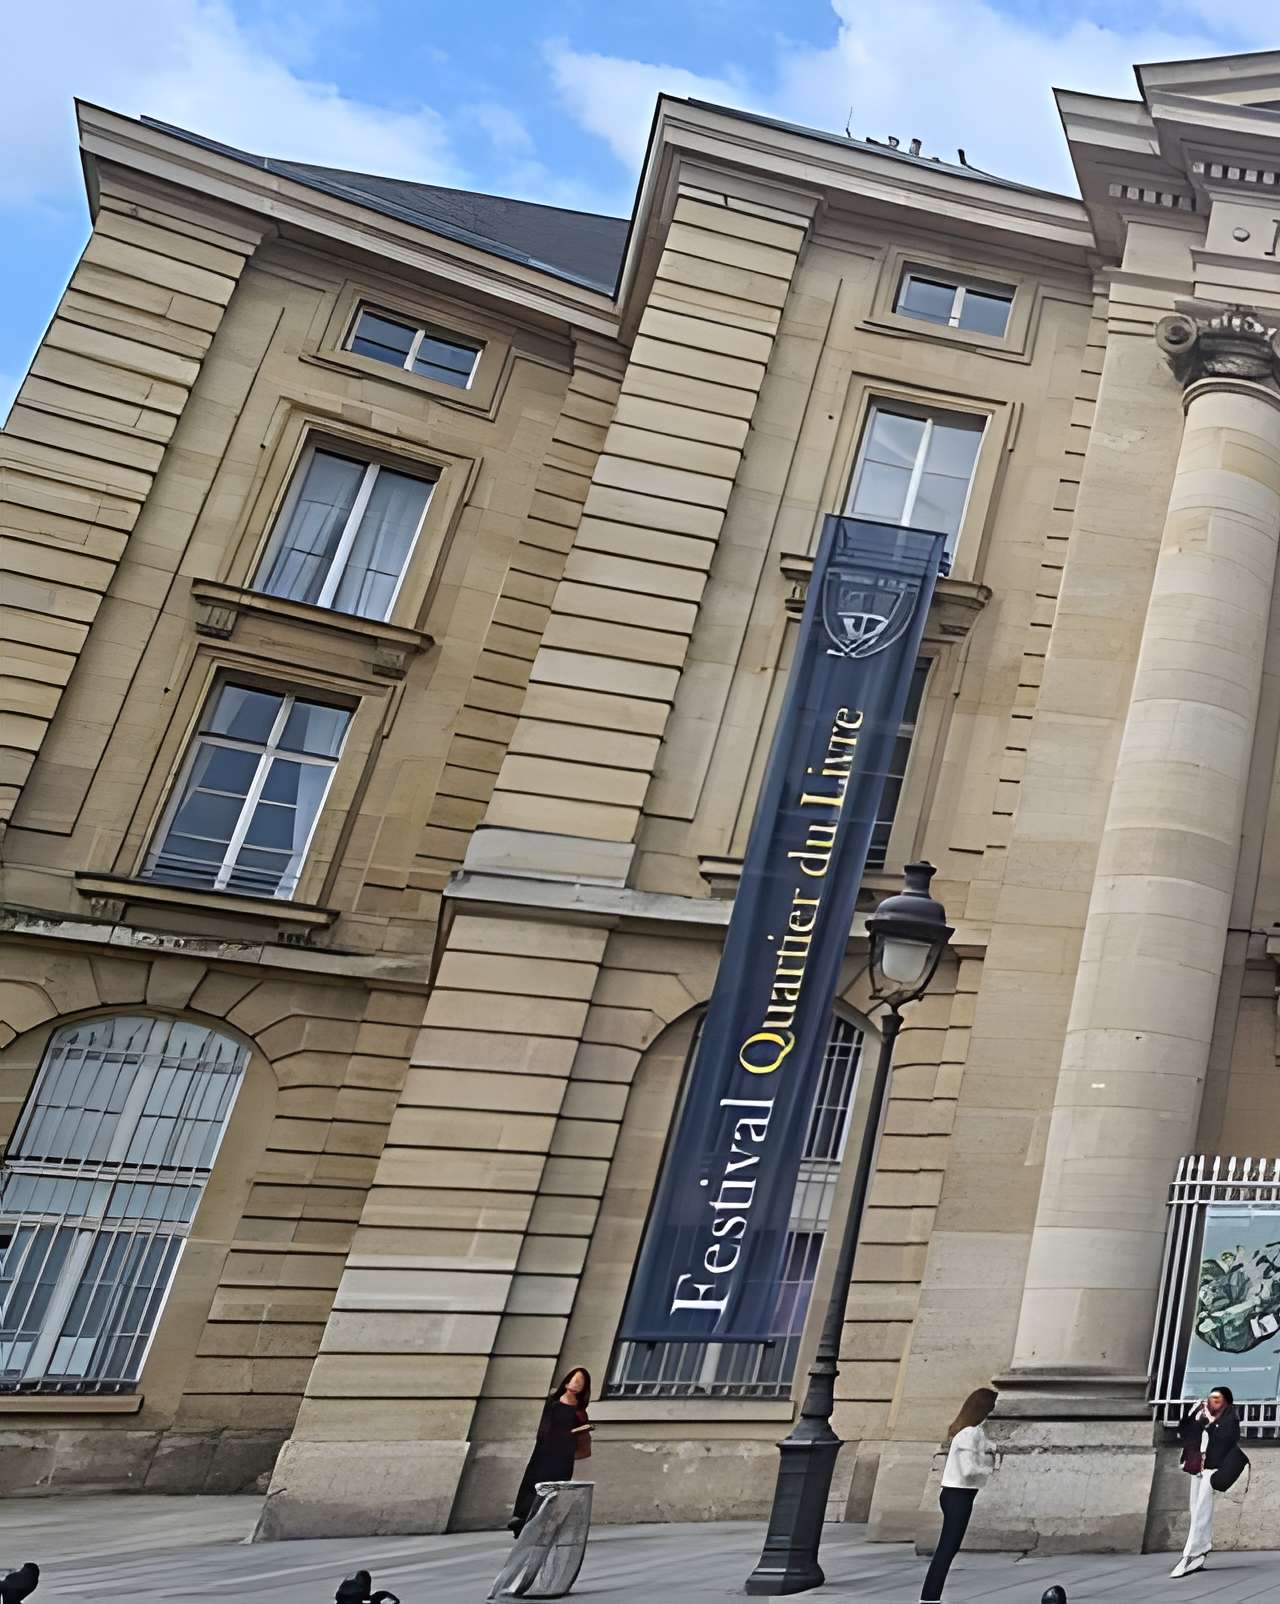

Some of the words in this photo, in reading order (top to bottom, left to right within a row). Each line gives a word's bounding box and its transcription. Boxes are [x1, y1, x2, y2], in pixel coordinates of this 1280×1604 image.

[800, 705, 864, 806] Livre
[787, 823, 838, 878] du
[739, 886, 821, 1075] Quartier
[669, 1096, 776, 1319] Festival
